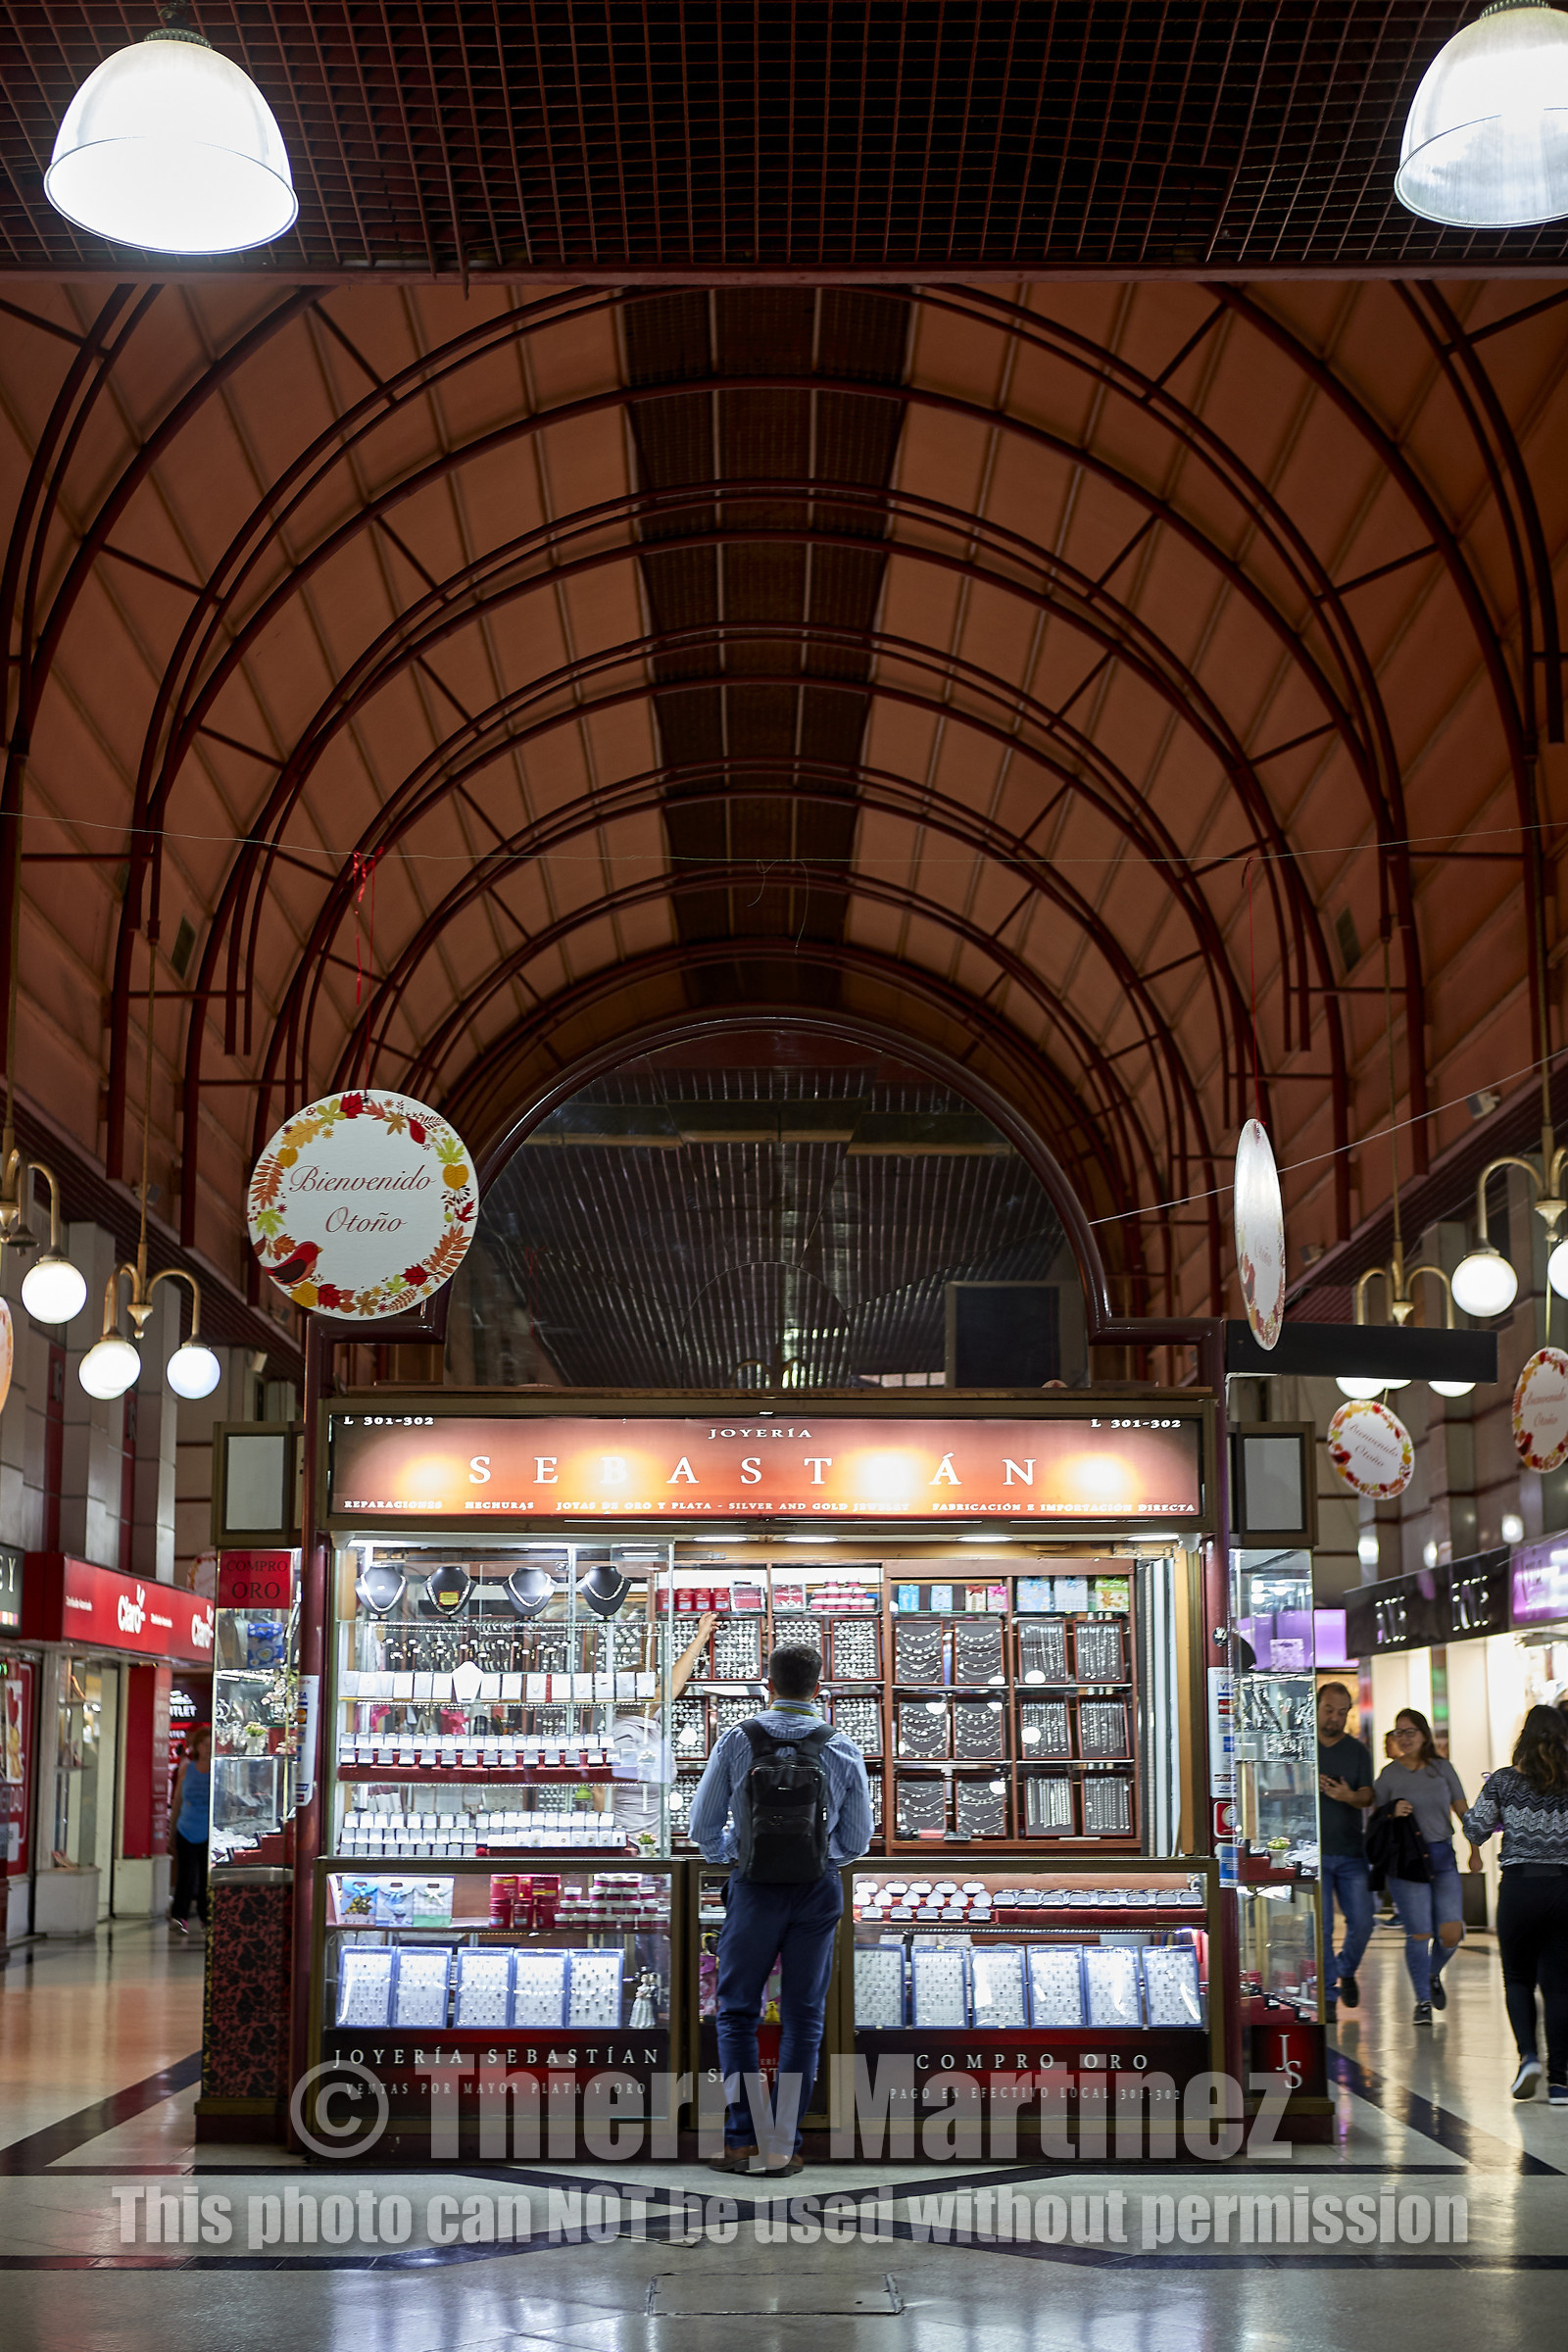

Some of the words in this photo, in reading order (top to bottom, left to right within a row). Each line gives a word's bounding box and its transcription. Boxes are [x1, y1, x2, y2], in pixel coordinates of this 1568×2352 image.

[289, 1164, 436, 1193] Bienvenido
[325, 1205, 408, 1233] Otoño
[343, 1416, 354, 1425] L
[364, 1417, 434, 1426] 301-302
[1090, 1418, 1102, 1428] L
[1110, 1419, 1181, 1429] 301-302
[708, 1427, 812, 1440] JOYERÍA
[344, 1500, 442, 1509] REPARACIONES
[556, 1501, 596, 1511] JOYAS
[624, 1501, 653, 1510] ORO
[657, 1501, 665, 1510] Y
[671, 1501, 711, 1510] PLATA
[811, 1502, 848, 1511] GOLD
[932, 1502, 1021, 1511] FABRICACIÓN
[1137, 1503, 1196, 1512] DIRECTA
[226, 1559, 288, 1572] COMPRO
[231, 1581, 280, 1599] ORO
[332, 2045, 463, 2069] JOYERÍA
[487, 2045, 658, 2064] SEBASTÍAN
[916, 2053, 1054, 2070] COMPRO
[1083, 2053, 1149, 2070] ORO
[346, 2082, 409, 2094] VENTAS
[420, 2082, 452, 2094] POR
[464, 2082, 518, 2094] MAYOR
[531, 2082, 582, 2094] PLATA
[594, 2082, 602, 2094] Y
[613, 2082, 646, 2094] ORO
[890, 2087, 930, 2099] PAGO
[941, 2087, 959, 2099] EN
[970, 2086, 1050, 2099] EFECTIVO
[1059, 2086, 1109, 2099] LOCAL
[1120, 2088, 1181, 2101] 301-302
